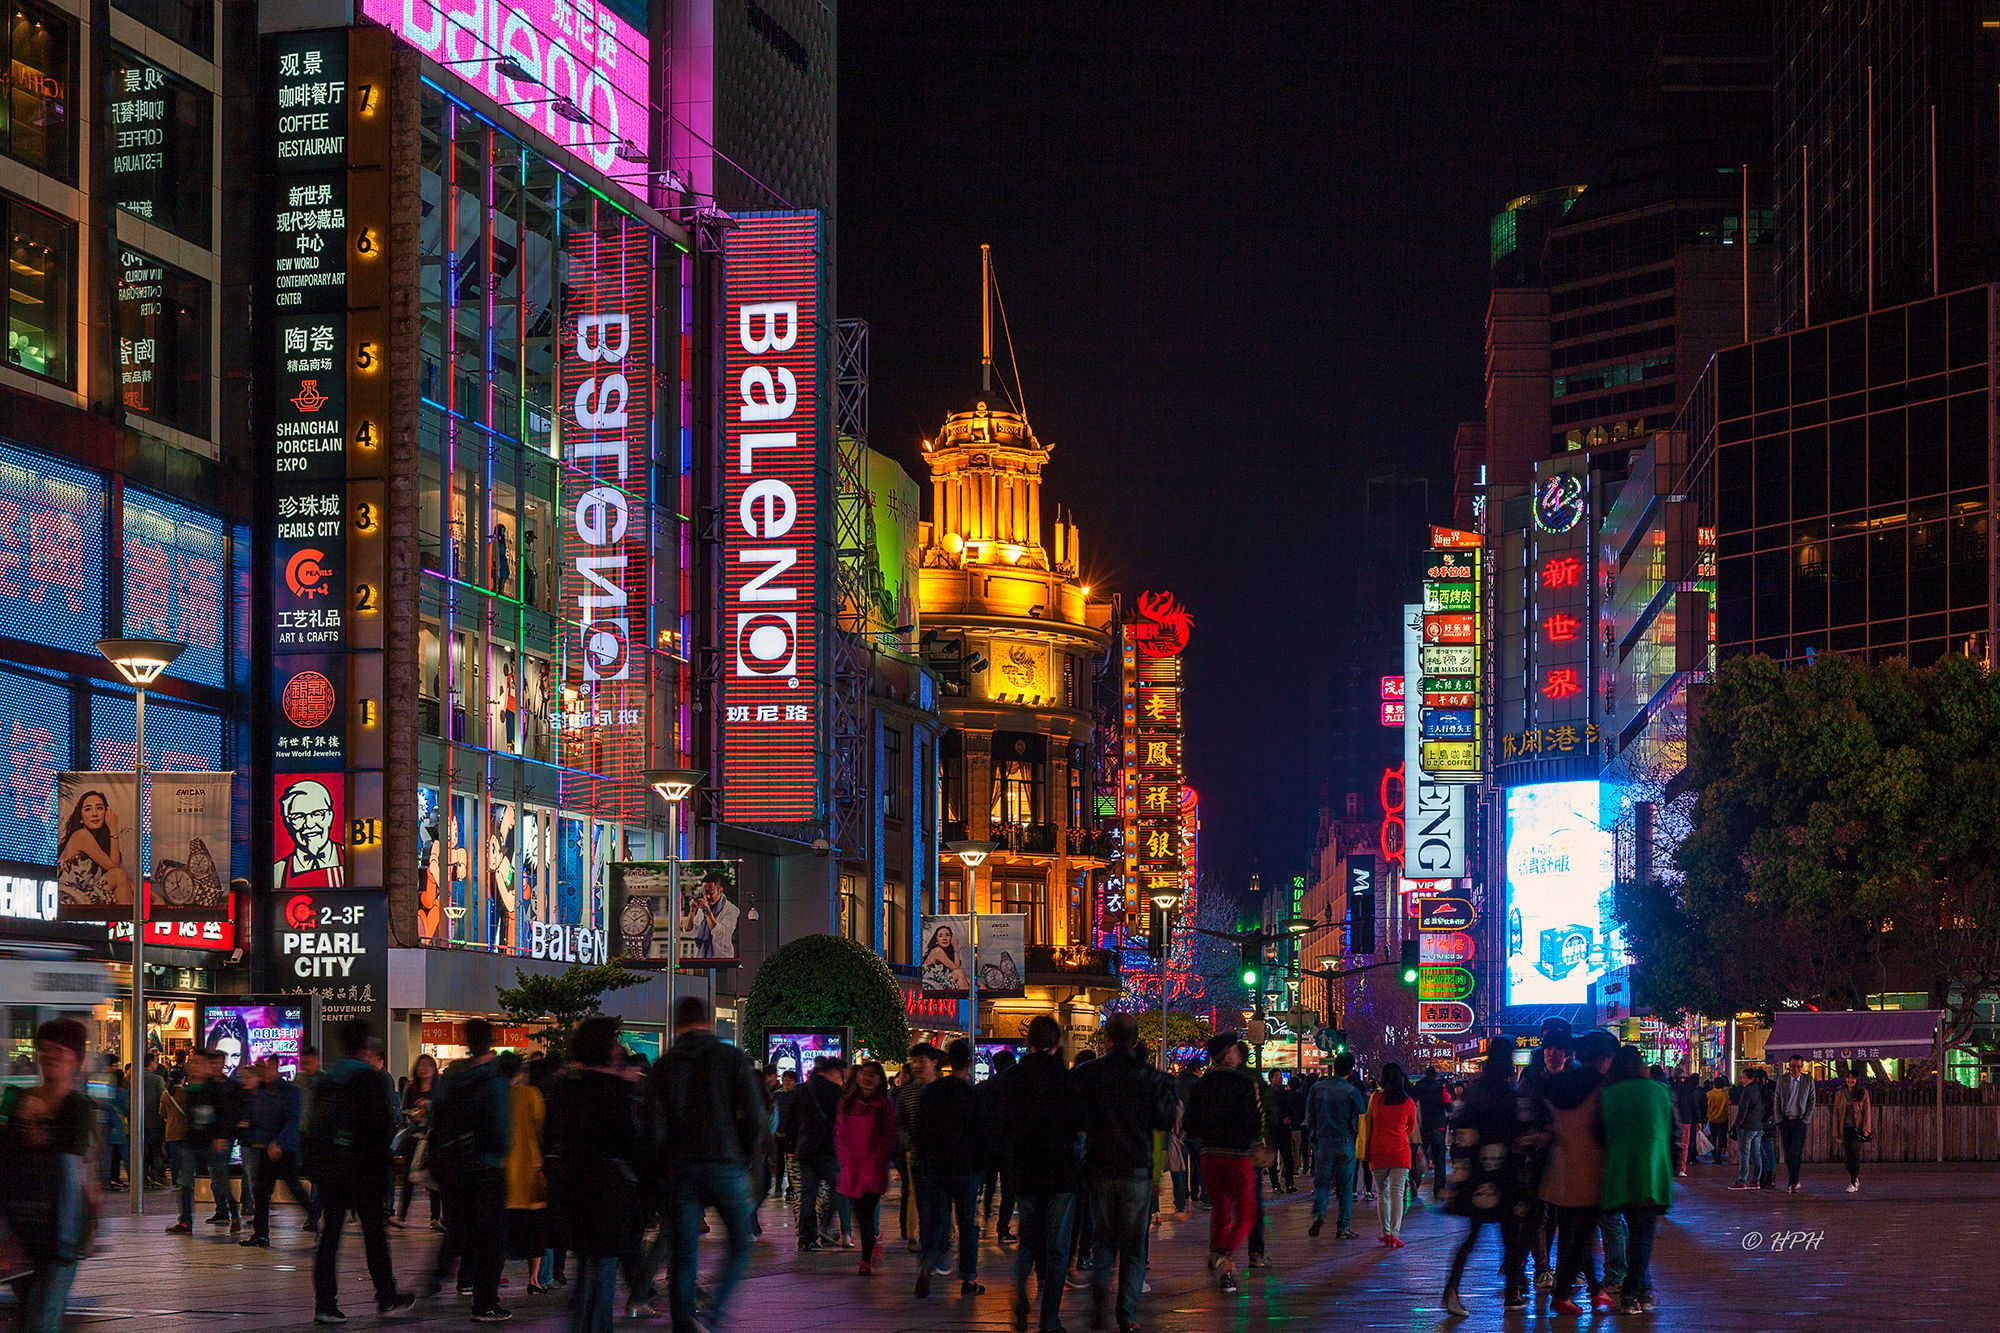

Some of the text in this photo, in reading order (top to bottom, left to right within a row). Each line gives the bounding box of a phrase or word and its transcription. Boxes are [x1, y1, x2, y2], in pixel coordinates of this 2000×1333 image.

[279, 51, 323, 76] 观景
[279, 82, 345, 109] 咖啡餐厅
[357, 84, 372, 112] 7
[278, 113, 329, 133] COFFEE
[277, 137, 345, 158] RESTAURANT
[289, 184, 333, 207] 新世界
[276, 208, 345, 232] 现代珍藏品
[296, 232, 325, 254] 中心
[357, 227, 372, 253] 6
[276, 256, 320, 271] NEW WORLD
[276, 272, 346, 288] CONTEMPORARY ART
[276, 292, 302, 305] CENTER
[284, 325, 335, 354] 陶瓷
[286, 357, 333, 372] 精品商场
[356, 342, 371, 369] 5
[276, 420, 339, 437] SHANGHAI
[355, 420, 371, 447] 4
[276, 437, 342, 454] PORCELAIN
[276, 457, 308, 472] EXPO
[279, 494, 340, 517] 珍珠城
[355, 503, 370, 530] 3
[278, 520, 341, 538] PEARLS CITY
[305, 569, 333, 577] PEARLS
[355, 583, 371, 611] 2
[1429, 588, 1472, 604] 巴西烤肉
[277, 608, 341, 629] 工艺礼品
[1541, 556, 1582, 698] 新世界
[279, 630, 339, 643] ART & CRAFTS
[726, 705, 809, 722] 班尼路
[351, 818, 376, 846] B1
[1417, 882, 1434, 891] VIP
[320, 905, 365, 925] 2-3F
[283, 932, 367, 955] PEARL
[294, 956, 356, 978] CITY
[321, 1005, 372, 1013] SOUVENIRS
[321, 1014, 355, 1022] CENTER
[1516, 1036, 1544, 1048] 新世
[1812, 1048, 1880, 1059] 城管 执法
